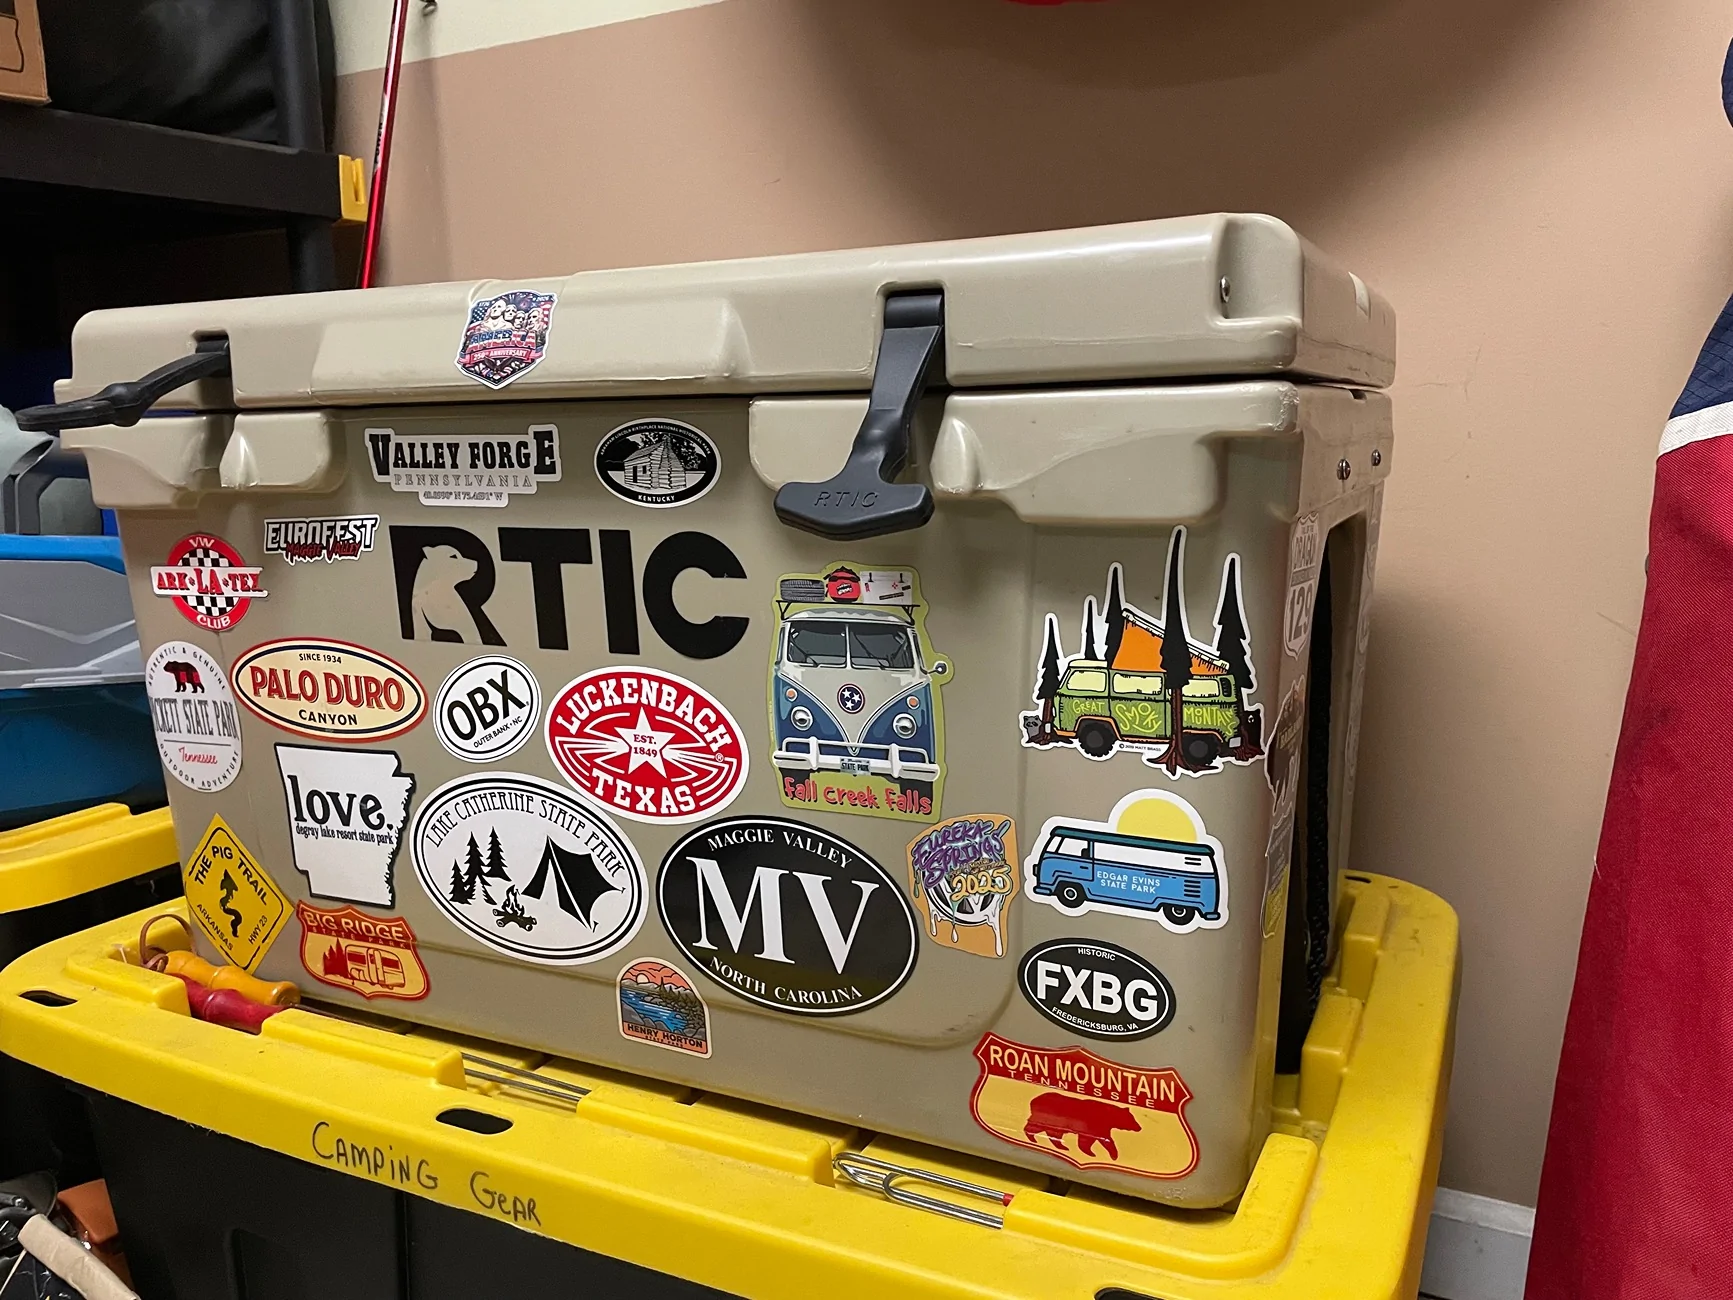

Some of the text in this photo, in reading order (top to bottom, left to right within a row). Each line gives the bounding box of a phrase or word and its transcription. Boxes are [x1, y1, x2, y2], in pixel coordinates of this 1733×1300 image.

[368, 430, 557, 476] VALLEY FORGE
[394, 474, 533, 488] PENNSYLVANIA
[638, 495, 675, 503] KENTUCKY
[814, 491, 879, 508] RTIC
[188, 536, 215, 549] VW
[267, 519, 376, 549] EUROFEST
[388, 524, 750, 660] RTIC
[196, 614, 231, 629] CLUB
[1288, 581, 1314, 643] 129
[148, 646, 226, 690] AUTHENTIC & GENUINE
[298, 653, 342, 664] SINCE 1934
[249, 665, 406, 712] PALO DURO
[182, 698, 214, 736] STATE
[298, 710, 358, 726] CANYON
[447, 669, 527, 741] OBX
[556, 677, 733, 753] LUCKENBACH
[1072, 699, 1105, 715] GREAT
[1115, 702, 1162, 733] SMOKY
[1183, 705, 1237, 736] MOUNTAINS
[473, 715, 523, 748] OUTER BANX NC
[633, 734, 657, 745] EST.
[160, 743, 196, 785] OUTDOOR
[178, 746, 218, 765] Tennessee
[633, 746, 658, 758] 1849
[840, 762, 856, 771] STATE
[591, 768, 696, 814] TEXAS
[295, 822, 394, 846] degray lake resort state park
[426, 791, 626, 878] LAKE CATHERINE STATE PARK
[707, 828, 853, 869] MAGGIE VALLEY
[912, 819, 994, 865] EUREKA
[923, 820, 1011, 889] SPRINGS
[194, 845, 268, 906] THE PIG TRAIL
[950, 866, 1012, 902] 2025
[1096, 870, 1161, 887] EDGAR EVINS
[1100, 879, 1157, 894] STATE PARK
[196, 903, 234, 951] ARKANSAS
[247, 915, 268, 945] HWY 23
[303, 911, 407, 943] BIG RIDGE
[685, 856, 880, 975] MV
[312, 926, 406, 949] STATE PARK
[1077, 947, 1116, 961] HISTORIC
[710, 956, 863, 1004] NORTH CAROLINA
[1036, 959, 1158, 1021] FXBG
[1051, 1006, 1139, 1032] FREDERICKSBURG, VA
[627, 1023, 659, 1038] HENRY
[662, 1033, 703, 1049] HORTON
[989, 1045, 1175, 1103] ROAN MOUNTAIN
[1008, 1069, 1155, 1109] TENNESSEE
